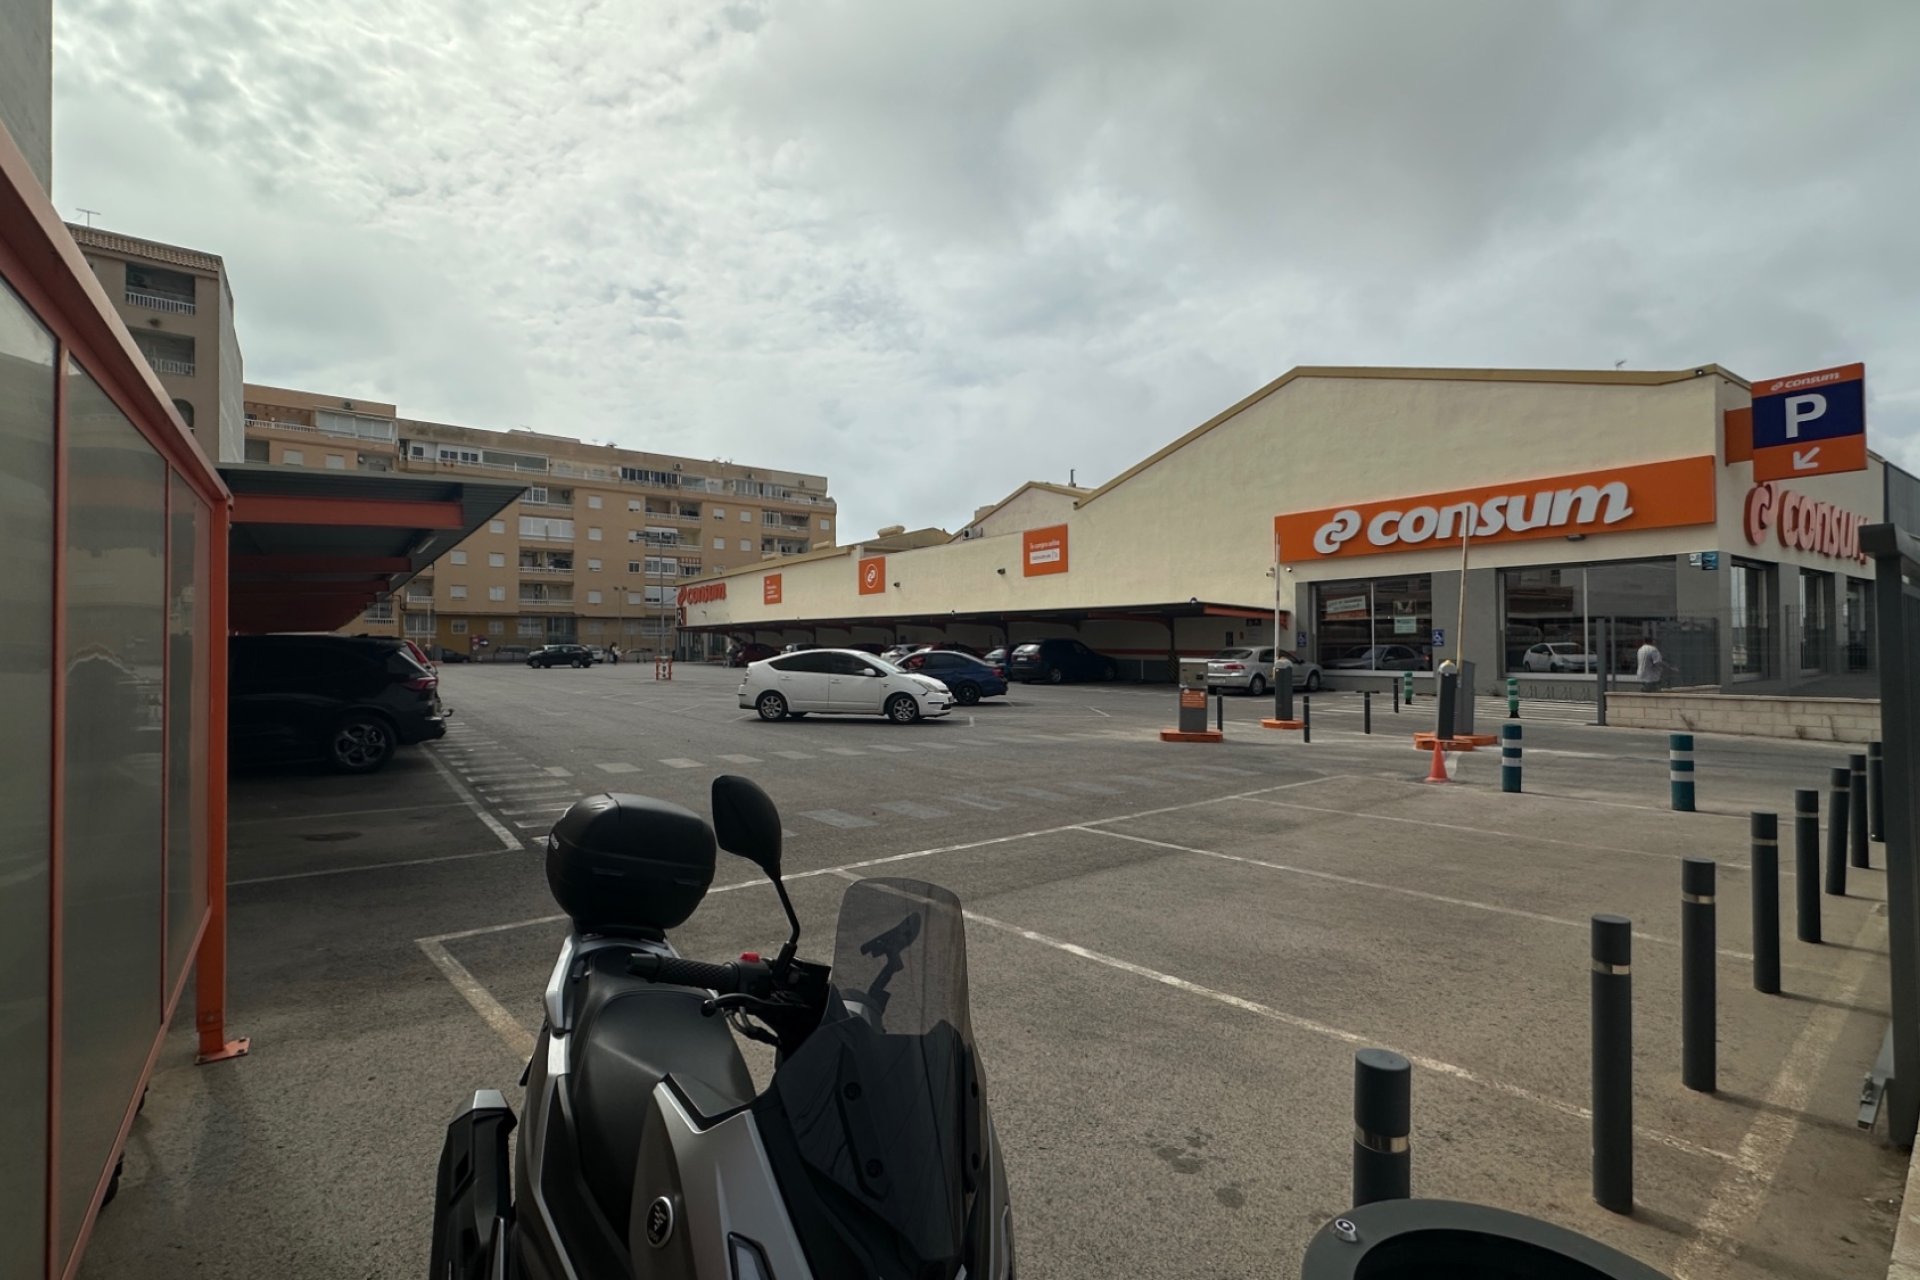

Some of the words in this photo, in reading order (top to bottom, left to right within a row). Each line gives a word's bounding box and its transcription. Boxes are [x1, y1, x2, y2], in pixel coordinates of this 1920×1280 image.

[1785, 372, 1840, 389] consum
[1785, 393, 1827, 439] P
[1367, 481, 1634, 546] consum
[687, 582, 727, 605] consum
